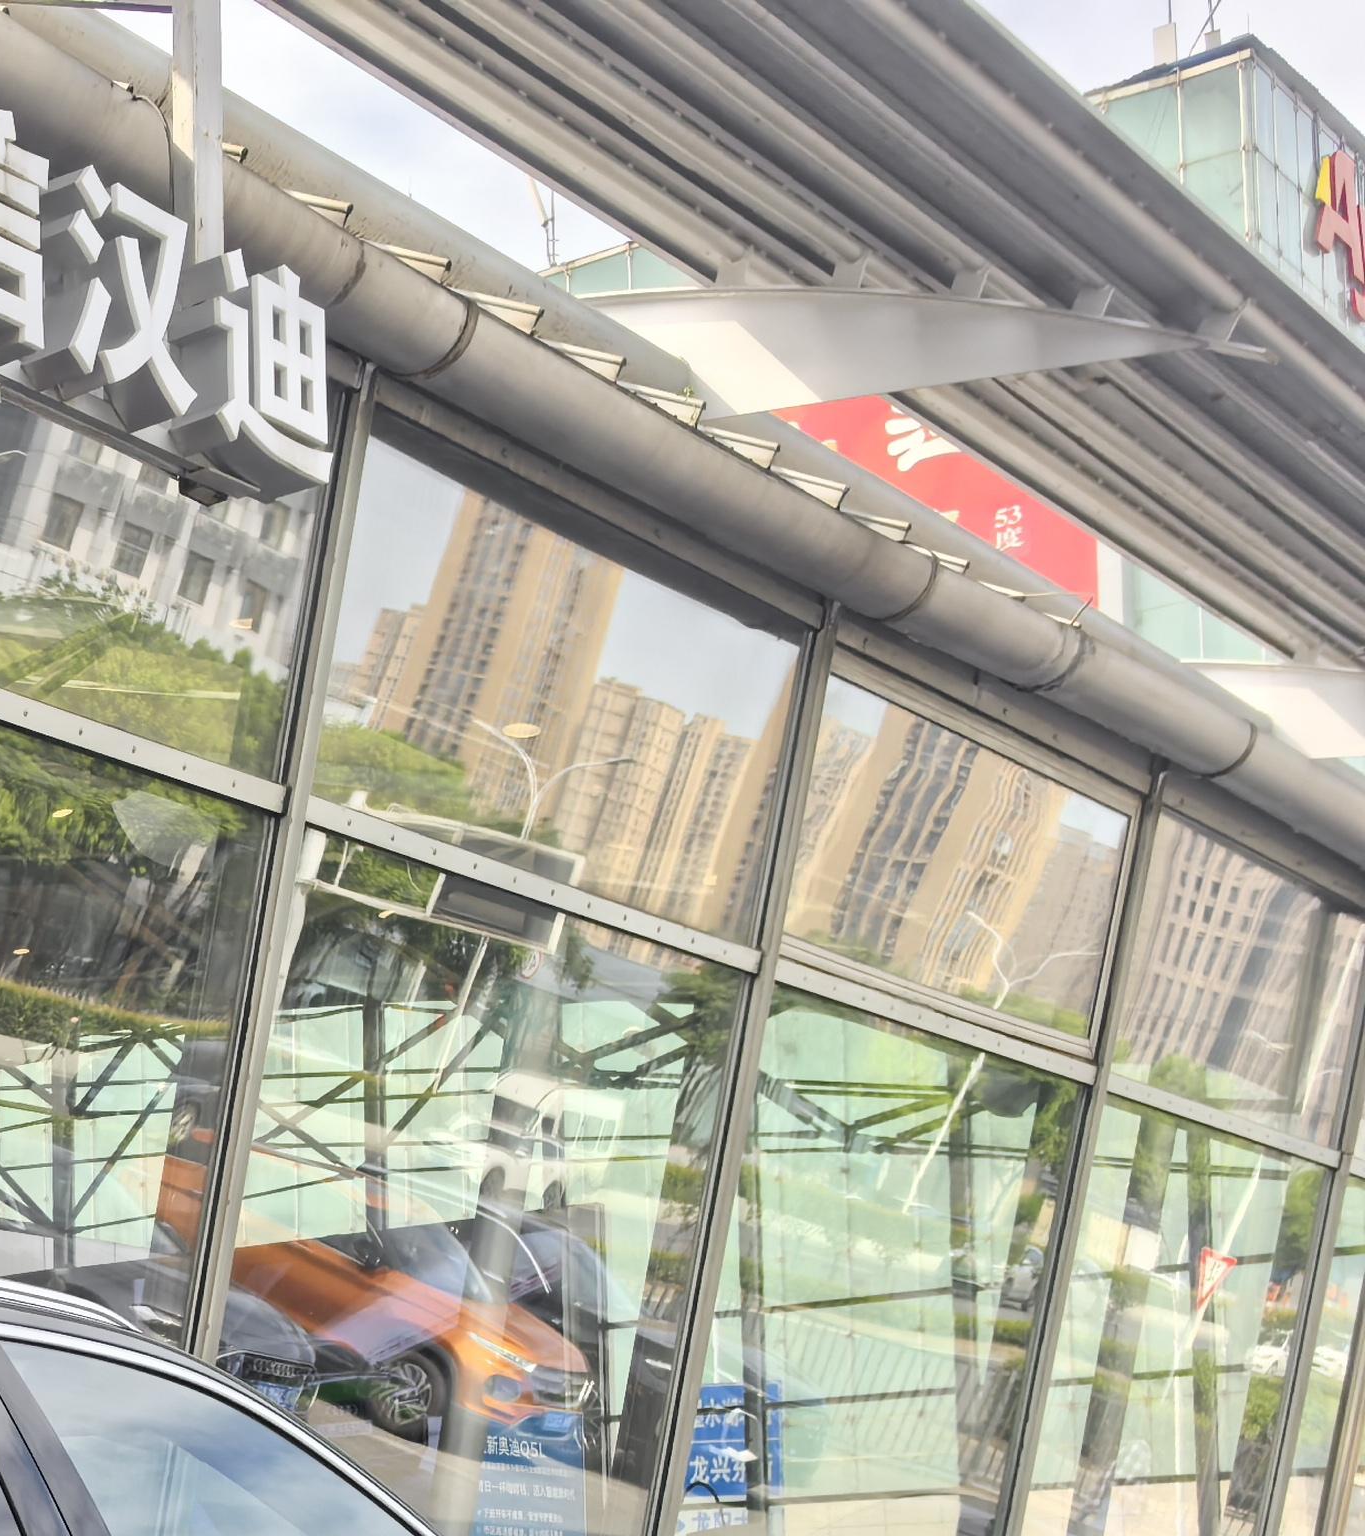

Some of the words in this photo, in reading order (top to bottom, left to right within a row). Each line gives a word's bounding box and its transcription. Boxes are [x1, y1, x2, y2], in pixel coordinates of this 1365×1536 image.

[994, 504, 1023, 528] 53
[483, 1435, 545, 1459] 新奥迪Q5L
